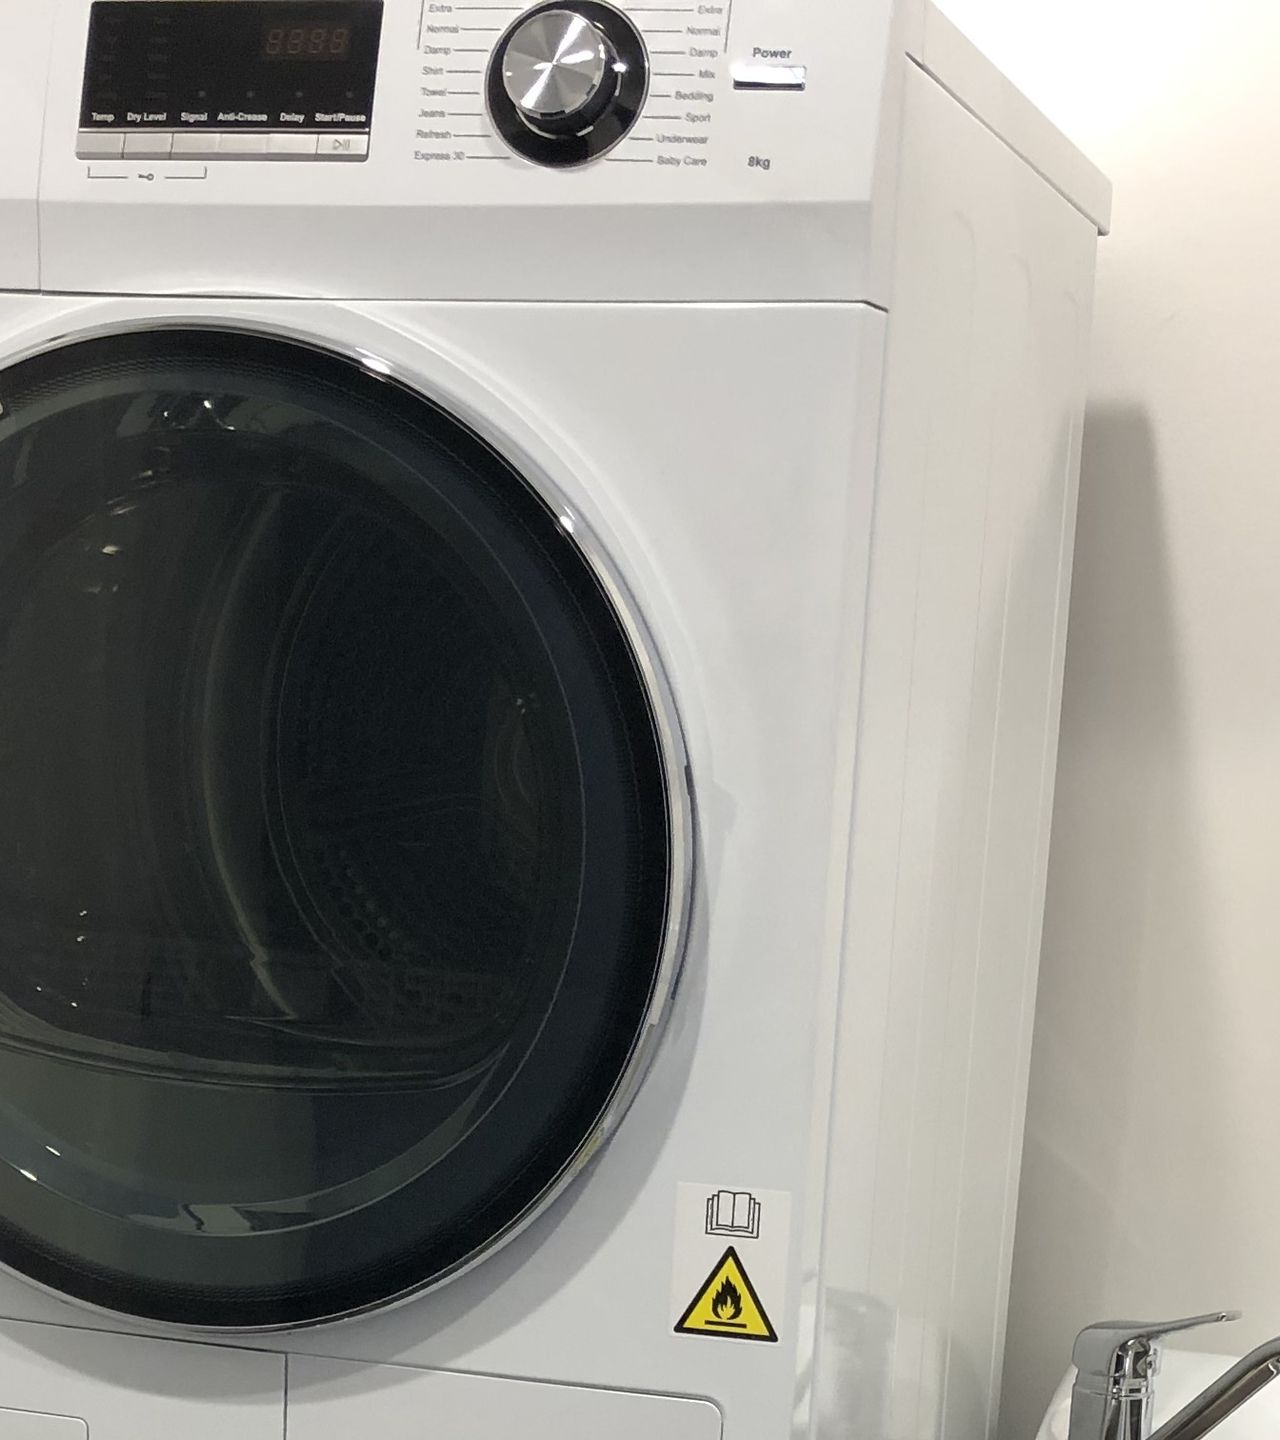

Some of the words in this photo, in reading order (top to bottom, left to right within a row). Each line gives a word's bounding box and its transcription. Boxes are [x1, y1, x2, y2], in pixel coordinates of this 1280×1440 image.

[428, 4, 452, 13] Extra
[698, 5, 723, 15] Extra
[427, 24, 459, 34] Normal
[687, 26, 720, 36] Normal
[424, 45, 451, 55] Damp
[689, 48, 718, 58] Damp
[752, 47, 792, 58] Power
[422, 66, 443, 75] Shirt
[699, 70, 715, 79] Mix
[421, 87, 446, 96] Towel
[674, 91, 714, 102] Bedding
[92, 113, 114, 122] Temp
[127, 113, 141, 122] Dry
[144, 113, 167, 121] Level
[181, 113, 207, 122] Signal
[217, 113, 267, 121] Anti-Crease
[280, 113, 304, 122] Delay
[315, 113, 366, 121] Start/Pause
[419, 109, 445, 118] Jeans
[685, 113, 711, 123] Sport
[416, 129, 451, 139] Refresh
[656, 134, 709, 144] Underwear
[414, 151, 450, 161] Express
[657, 155, 681, 167] Baby
[684, 156, 707, 166] Care
[748, 156, 770, 170] 8kg
